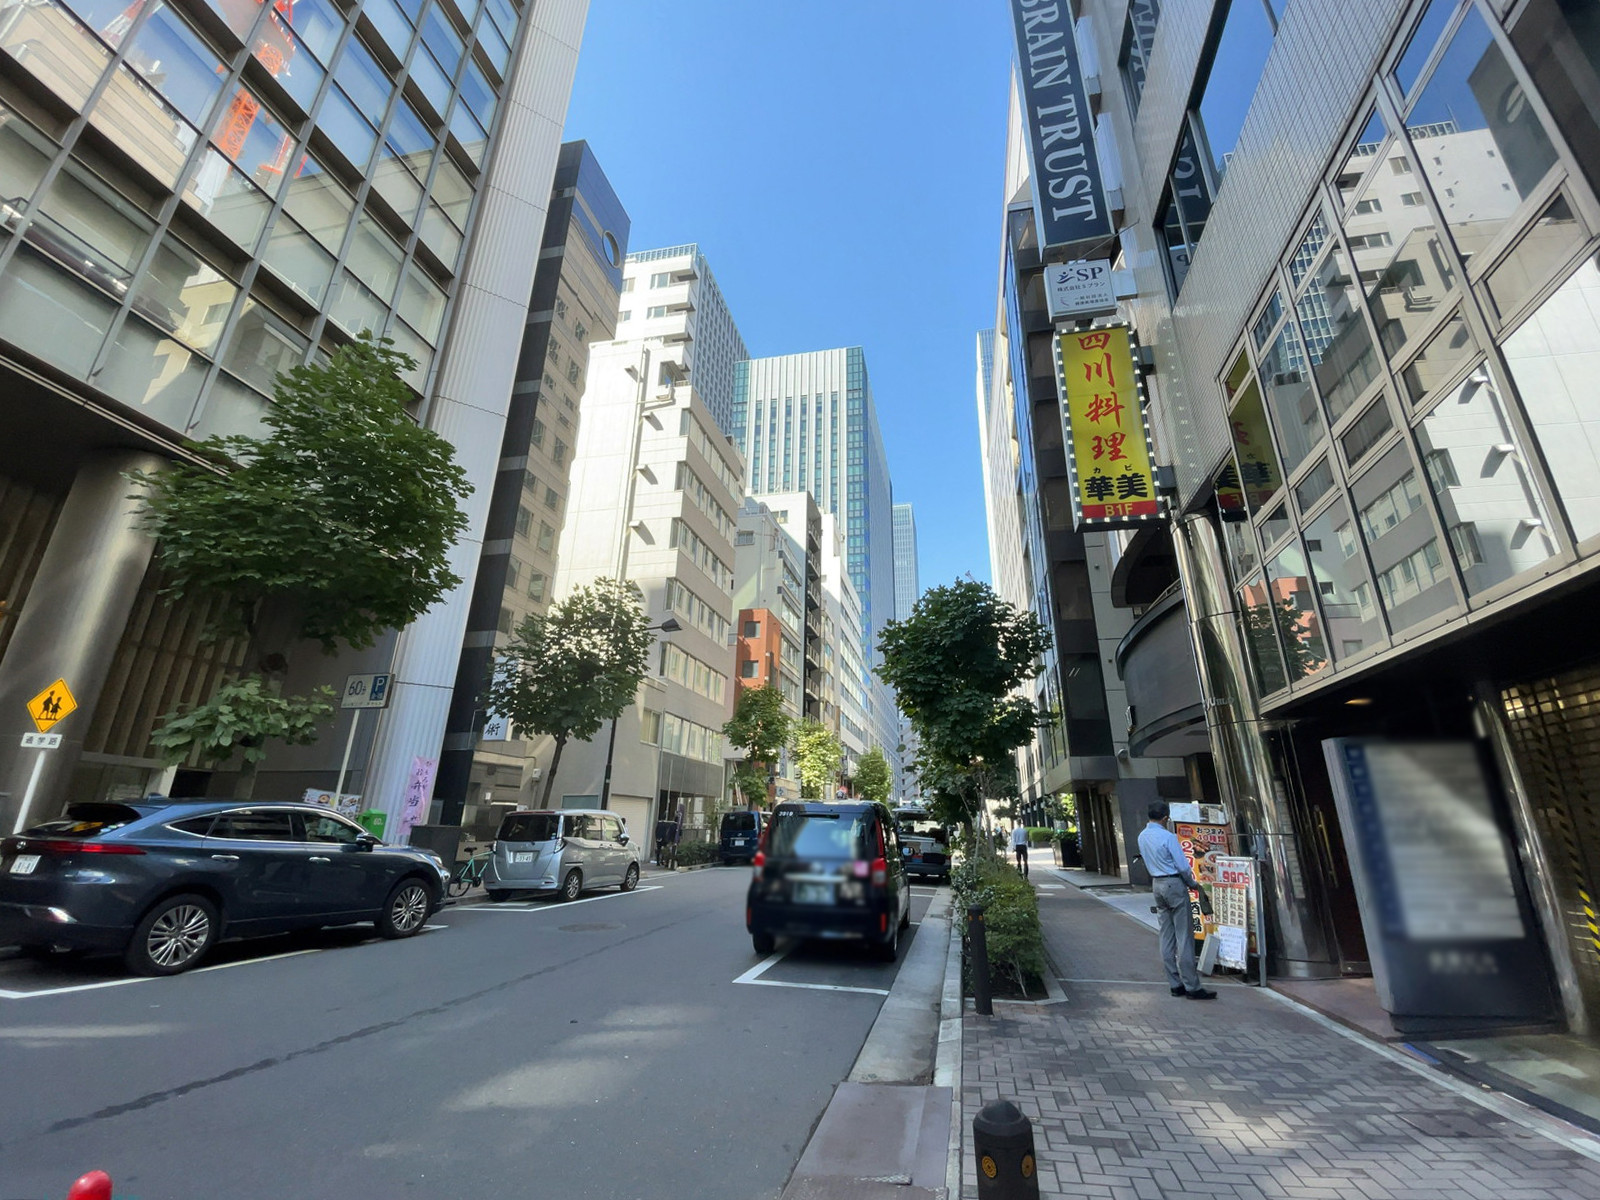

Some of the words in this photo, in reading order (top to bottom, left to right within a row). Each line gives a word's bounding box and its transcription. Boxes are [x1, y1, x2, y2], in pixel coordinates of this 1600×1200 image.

[1020, 0, 1072, 89] RAIN
[1036, 94, 1098, 222] TRUST
[1076, 266, 1104, 282] SP
[1077, 331, 1128, 462] 四川料理
[1084, 472, 1148, 501] 華美
[1104, 503, 1133, 517] B1F
[375, 677, 384, 692] P
